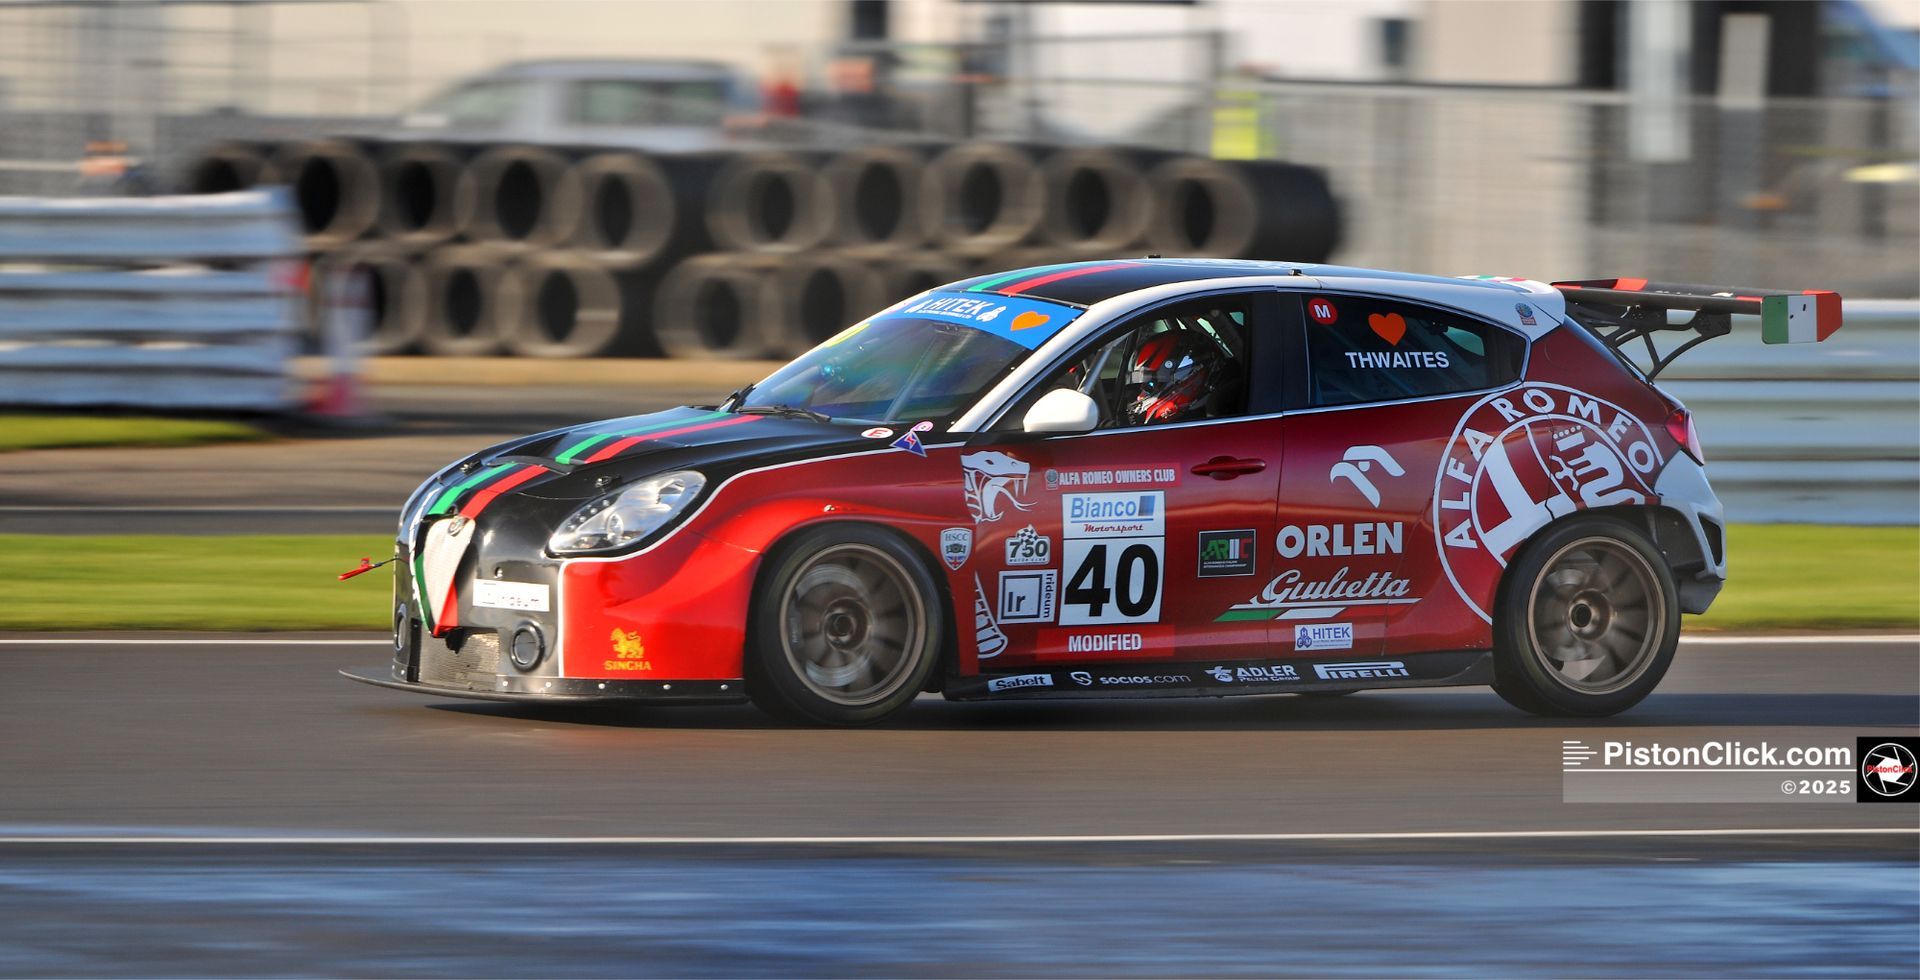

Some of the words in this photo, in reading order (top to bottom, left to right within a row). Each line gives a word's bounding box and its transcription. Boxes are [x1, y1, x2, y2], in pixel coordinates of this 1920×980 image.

[924, 298, 995, 315] HITEK
[1314, 305, 1331, 318] M
[1345, 351, 1450, 368] THWAITES
[1059, 472, 1081, 485] ALFA
[1082, 471, 1112, 485] ROMEO
[1115, 470, 1152, 484] OWNERS
[1154, 469, 1176, 482] CLUB
[1441, 427, 1494, 549] ALFA
[1489, 389, 1655, 474] ROMEO
[1070, 496, 1137, 518] Bianco
[1084, 523, 1144, 533] Motorsport
[945, 533, 968, 541] HSCC
[1276, 522, 1403, 558] ORLEN
[1009, 540, 1048, 558] 750
[1064, 544, 1159, 617] 40
[1256, 566, 1411, 604] Giulietta
[1007, 591, 1026, 612] Ir
[1043, 573, 1054, 618] Irideum
[1312, 626, 1351, 639] HITEK
[1068, 633, 1142, 652] MODIFIED
[604, 660, 652, 671] SINGHA
[1237, 664, 1298, 677] ADLER
[1312, 661, 1410, 680] PIRELLI
[995, 674, 1046, 689] Sabelt
